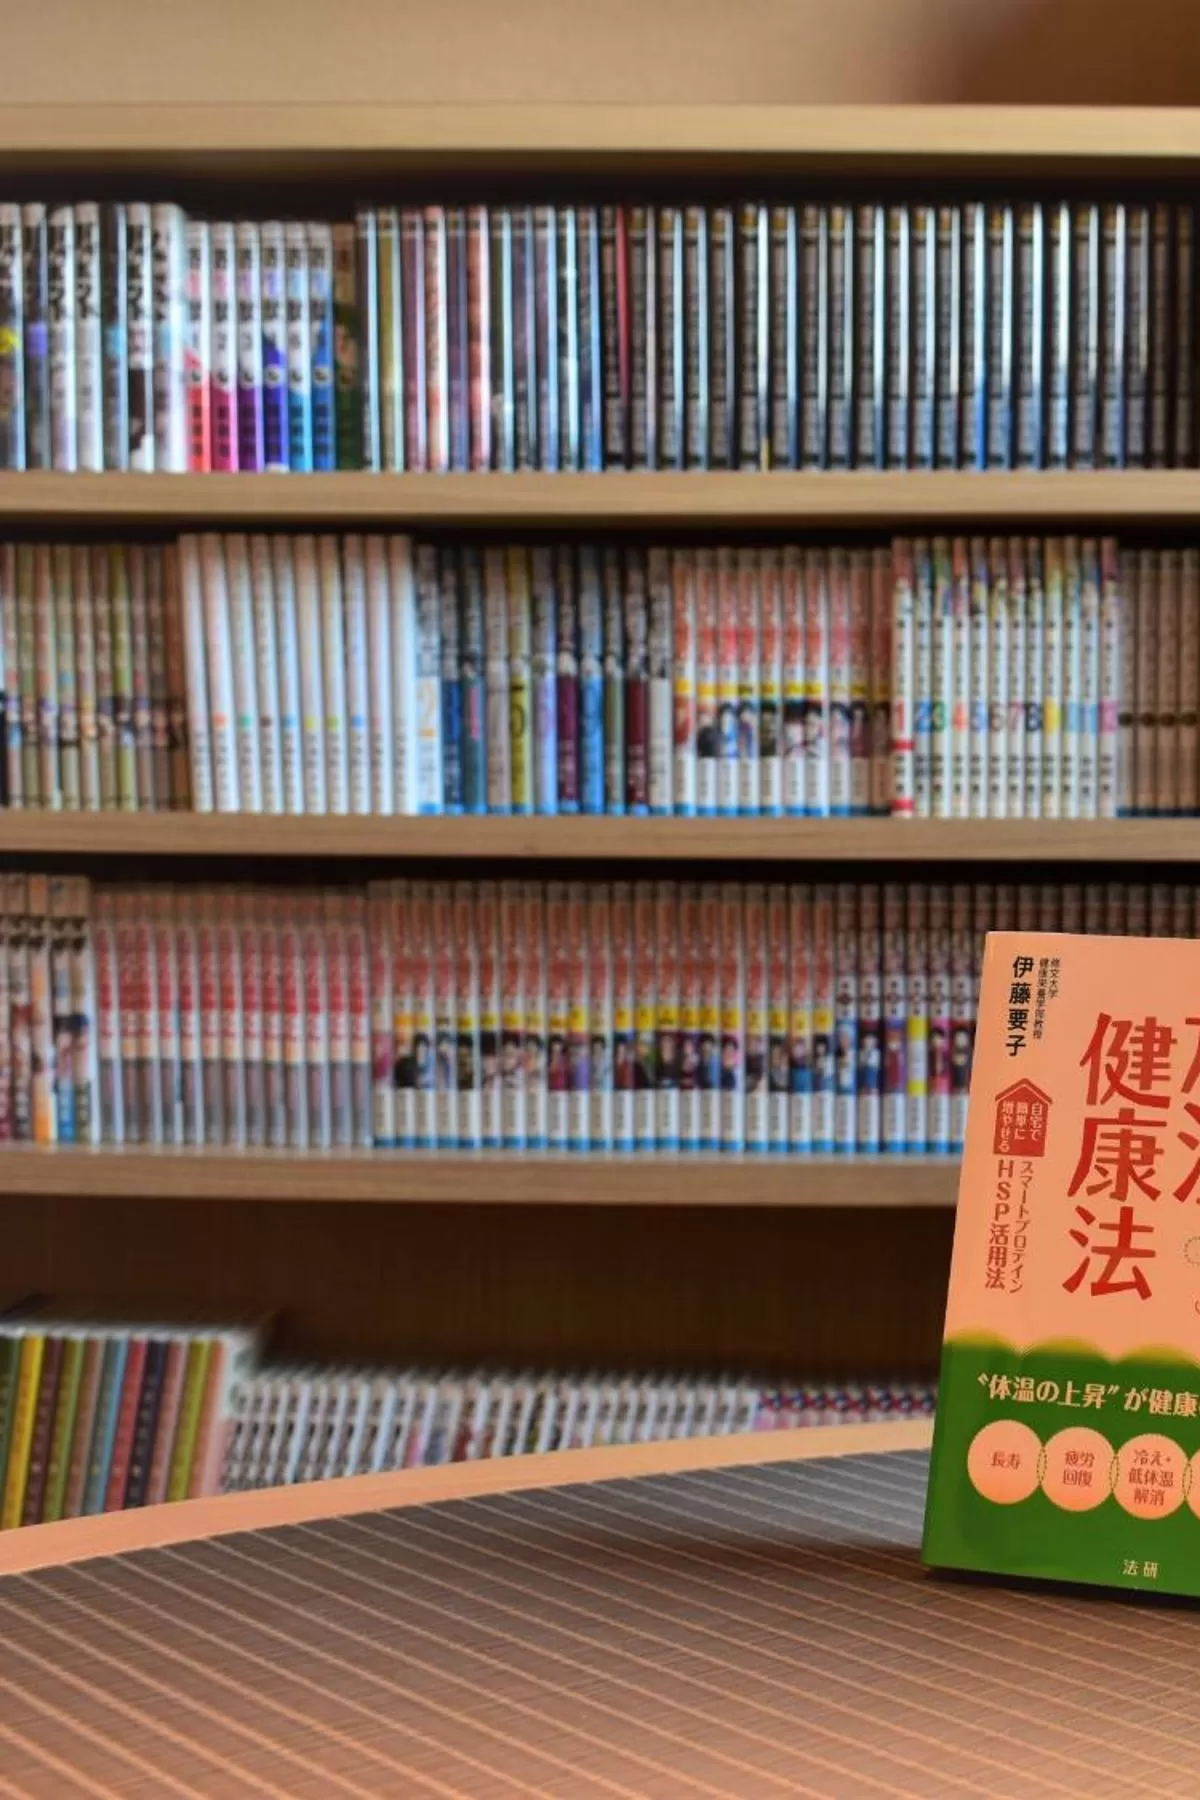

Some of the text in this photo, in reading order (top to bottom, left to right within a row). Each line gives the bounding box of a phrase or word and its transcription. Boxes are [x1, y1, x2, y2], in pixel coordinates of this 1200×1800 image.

[1005, 955, 1034, 1056] 伊藤要子
[1030, 1103, 1043, 1141] 自宅で
[1062, 1012, 1178, 1301] 健康法
[985, 1160, 1014, 1290] HSP活用法
[1009, 1161, 1033, 1294] スマートプロテイン
[990, 1450, 1021, 1470] 長寿
[1064, 1449, 1096, 1468] 疲労
[1062, 1468, 1093, 1488] 回復
[1127, 1468, 1175, 1489] 低体温
[1133, 1488, 1166, 1507] 解消
[1122, 1559, 1160, 1580] 法研
